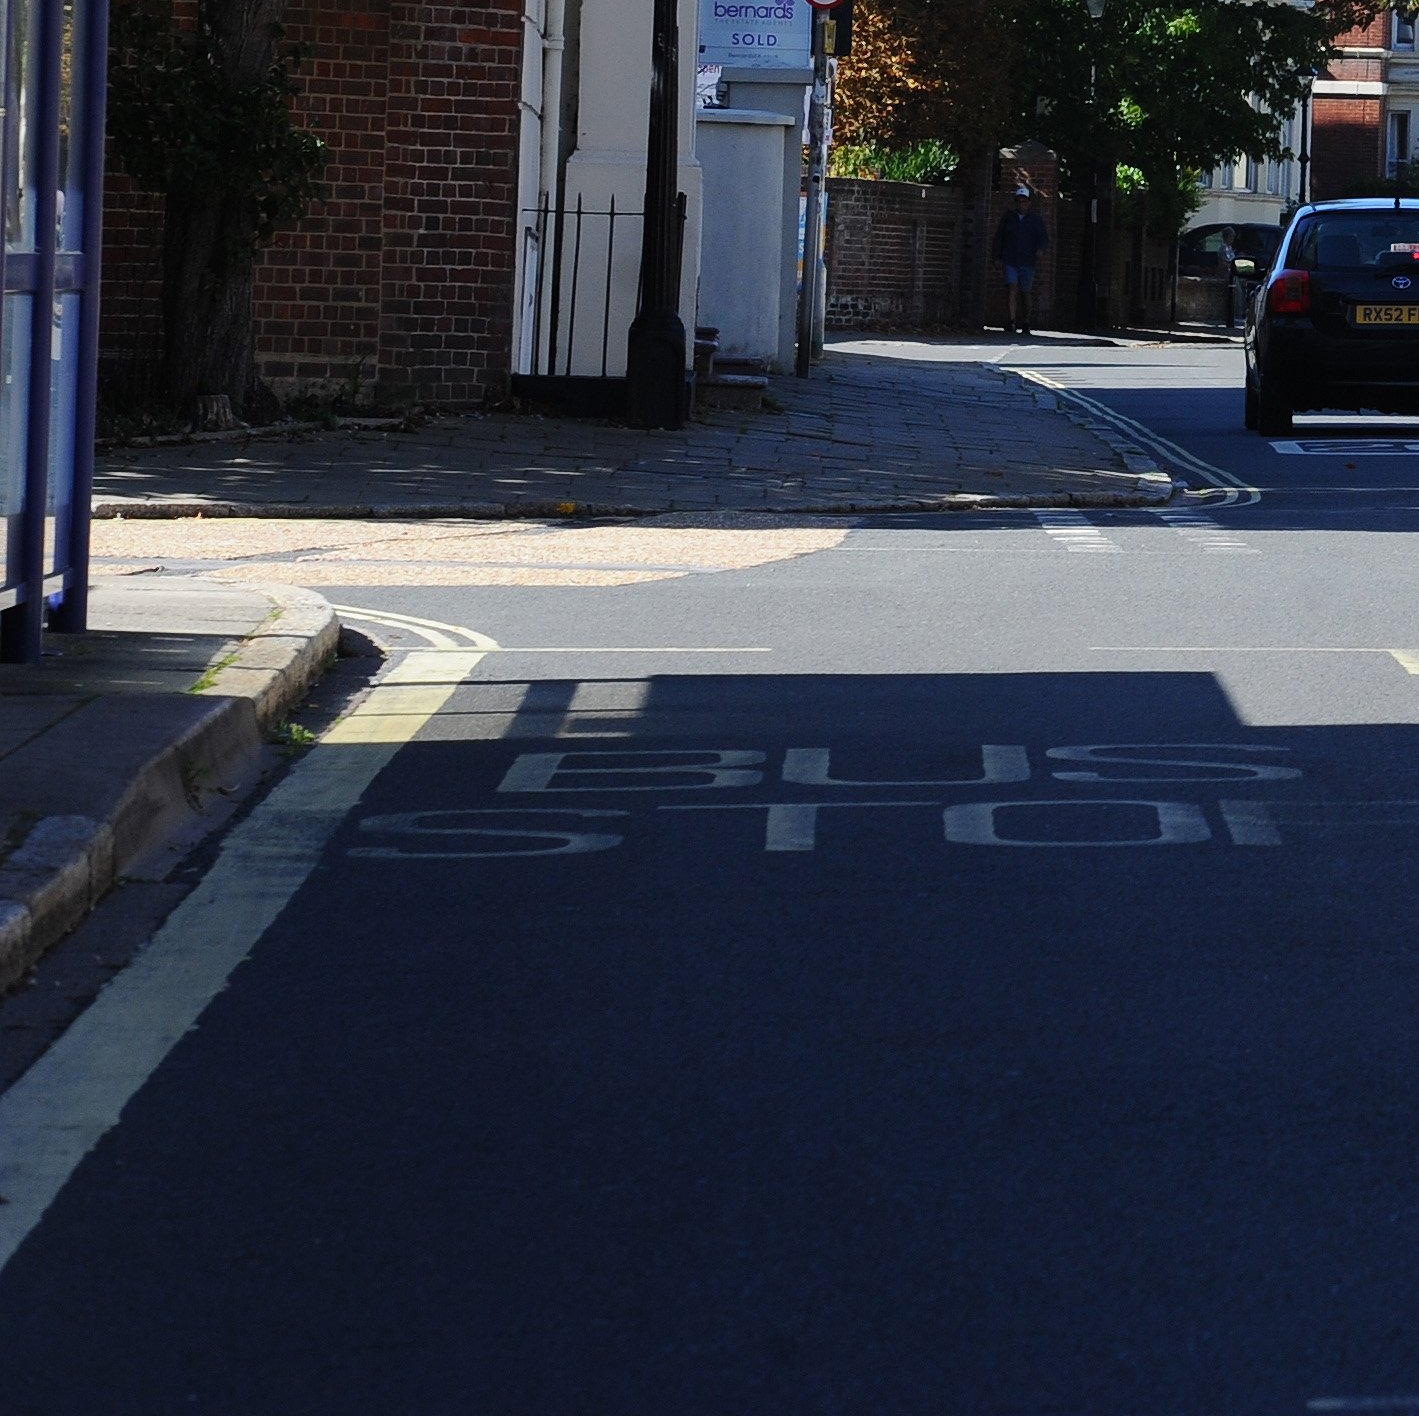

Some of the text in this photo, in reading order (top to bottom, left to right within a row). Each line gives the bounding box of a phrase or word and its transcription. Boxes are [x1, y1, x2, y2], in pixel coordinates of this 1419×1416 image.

[715, 1, 793, 19] bernards
[731, 33, 777, 46] SOLD
[1363, 307, 1403, 322] RX52
[497, 744, 1302, 792] BUS
